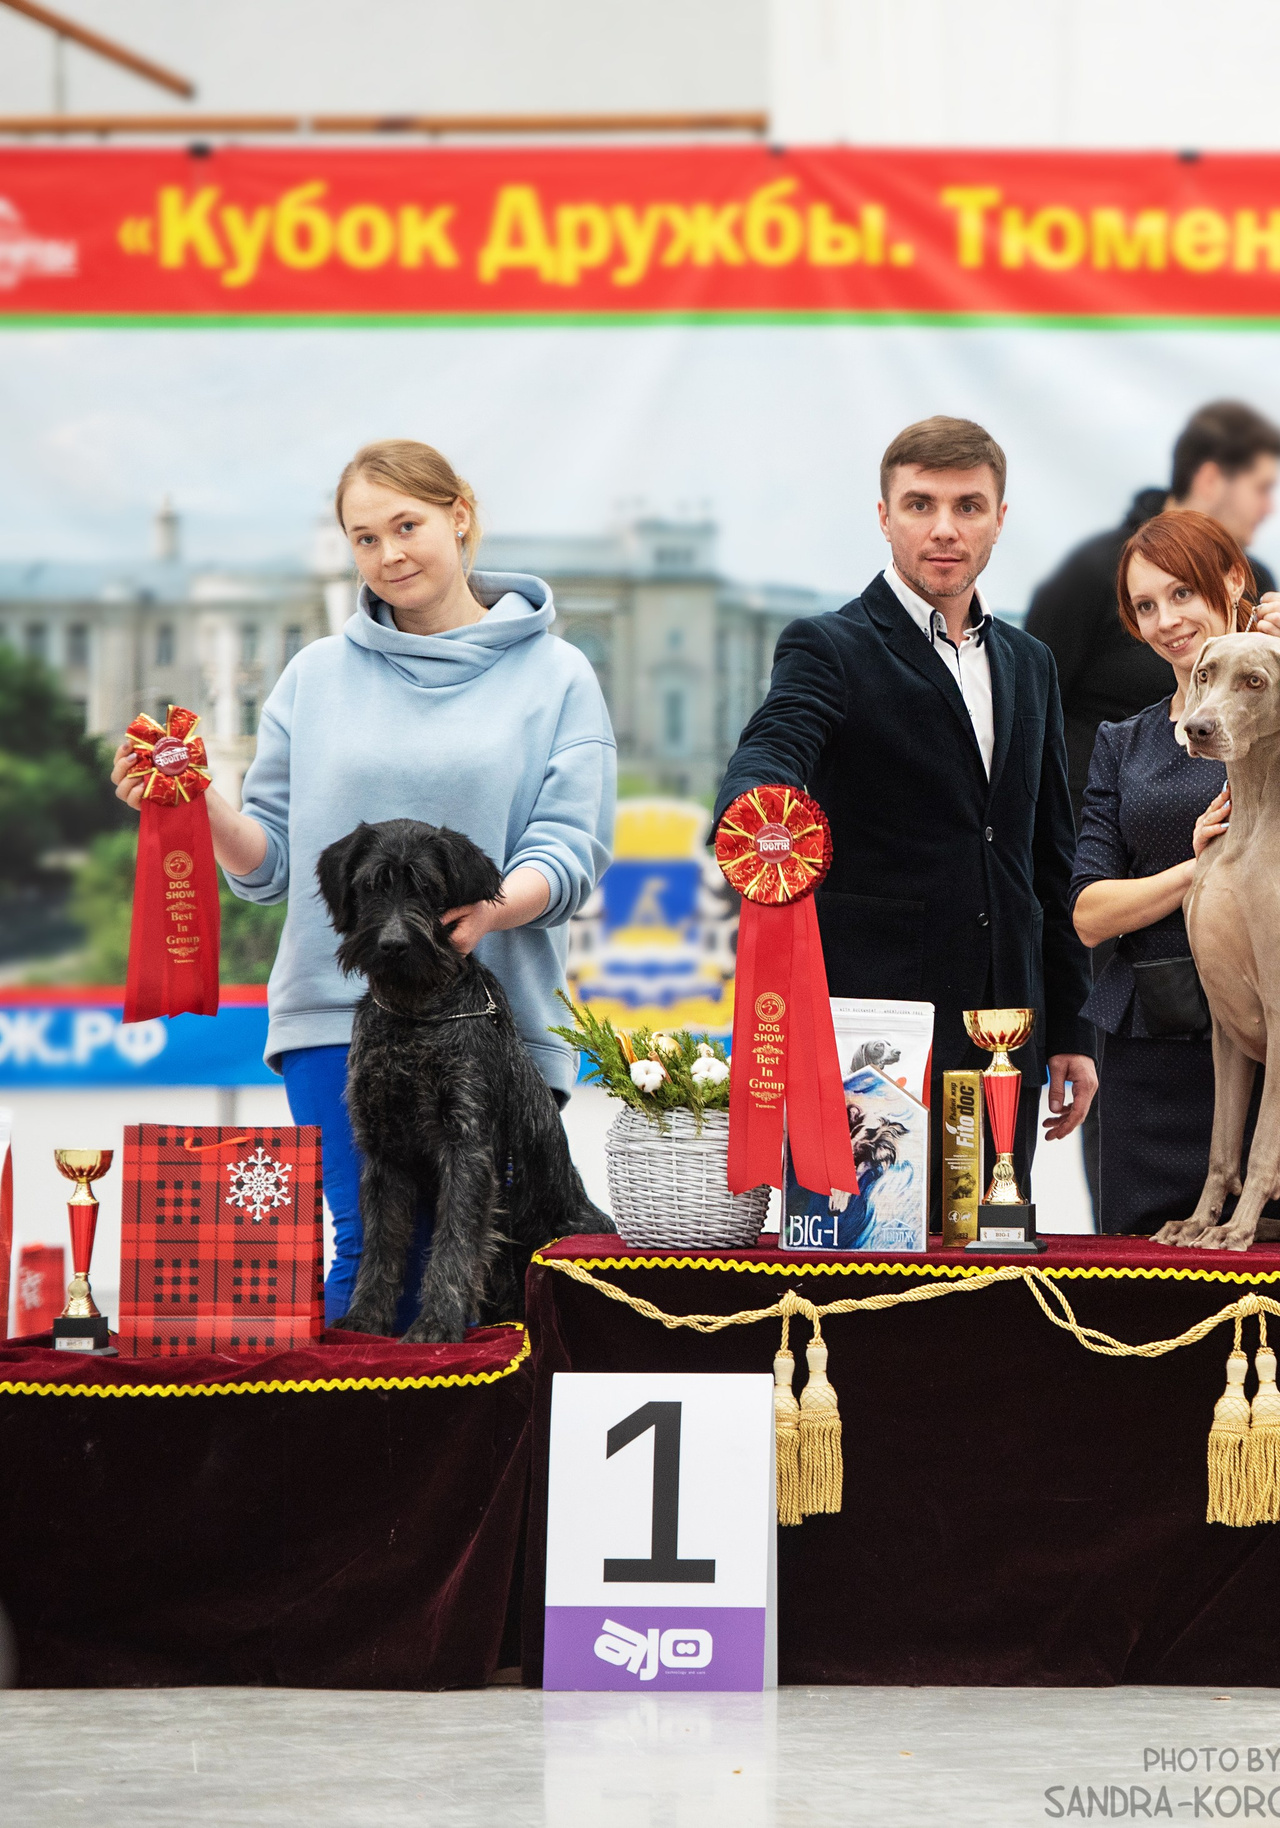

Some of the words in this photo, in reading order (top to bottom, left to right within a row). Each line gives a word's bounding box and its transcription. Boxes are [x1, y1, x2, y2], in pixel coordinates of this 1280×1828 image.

[119, 181, 459, 287] «Кубок
[478, 177, 917, 287] Дружбы.
[169, 881, 190, 889] DOG
[166, 890, 195, 899] SHOW
[171, 912, 193, 921] Best
[177, 923, 188, 932] In
[166, 935, 200, 945] Group
[758, 1023, 780, 1032] DOG
[753, 1033, 785, 1042] SHOW
[756, 1054, 779, 1065] Best
[761, 1067, 773, 1077] In
[749, 1078, 785, 1091] Group
[603, 1401, 716, 1583] 1
